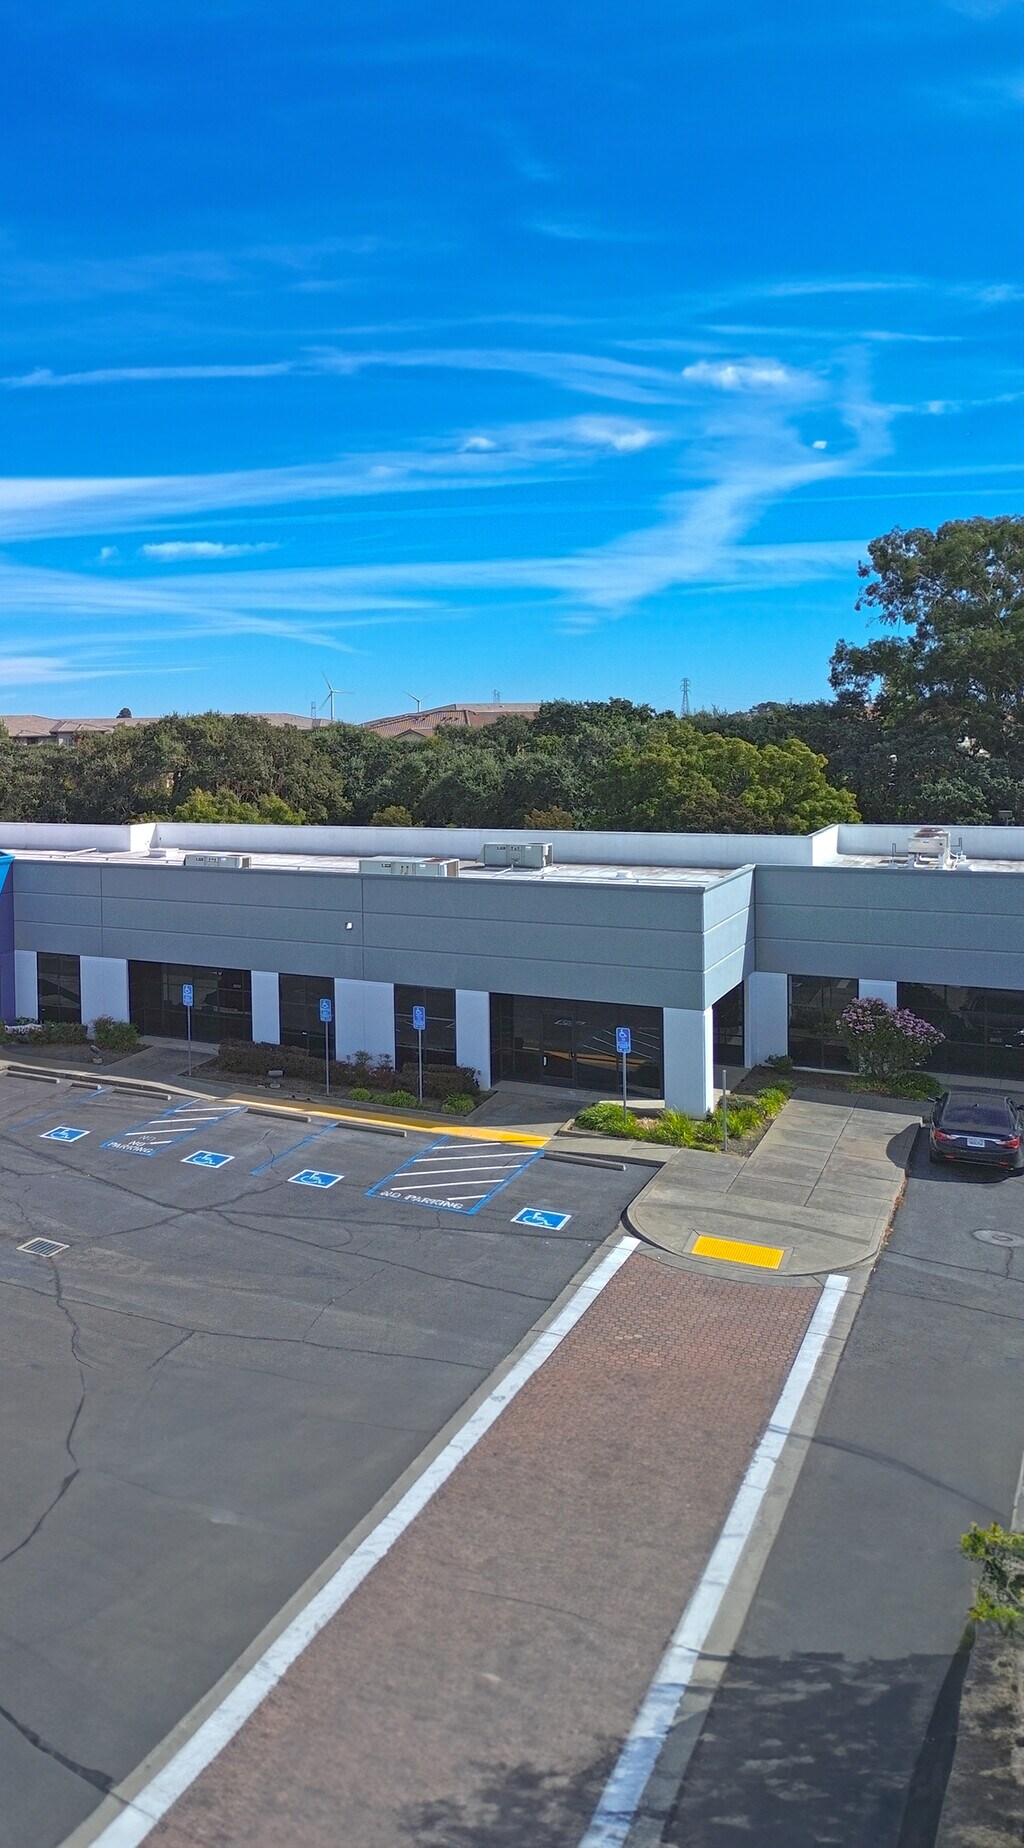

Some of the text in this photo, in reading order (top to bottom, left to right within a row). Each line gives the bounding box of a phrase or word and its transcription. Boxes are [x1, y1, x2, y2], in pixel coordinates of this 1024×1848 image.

[107, 1142, 154, 1153] PARKING
[380, 1190, 463, 1209] NO PARKING
